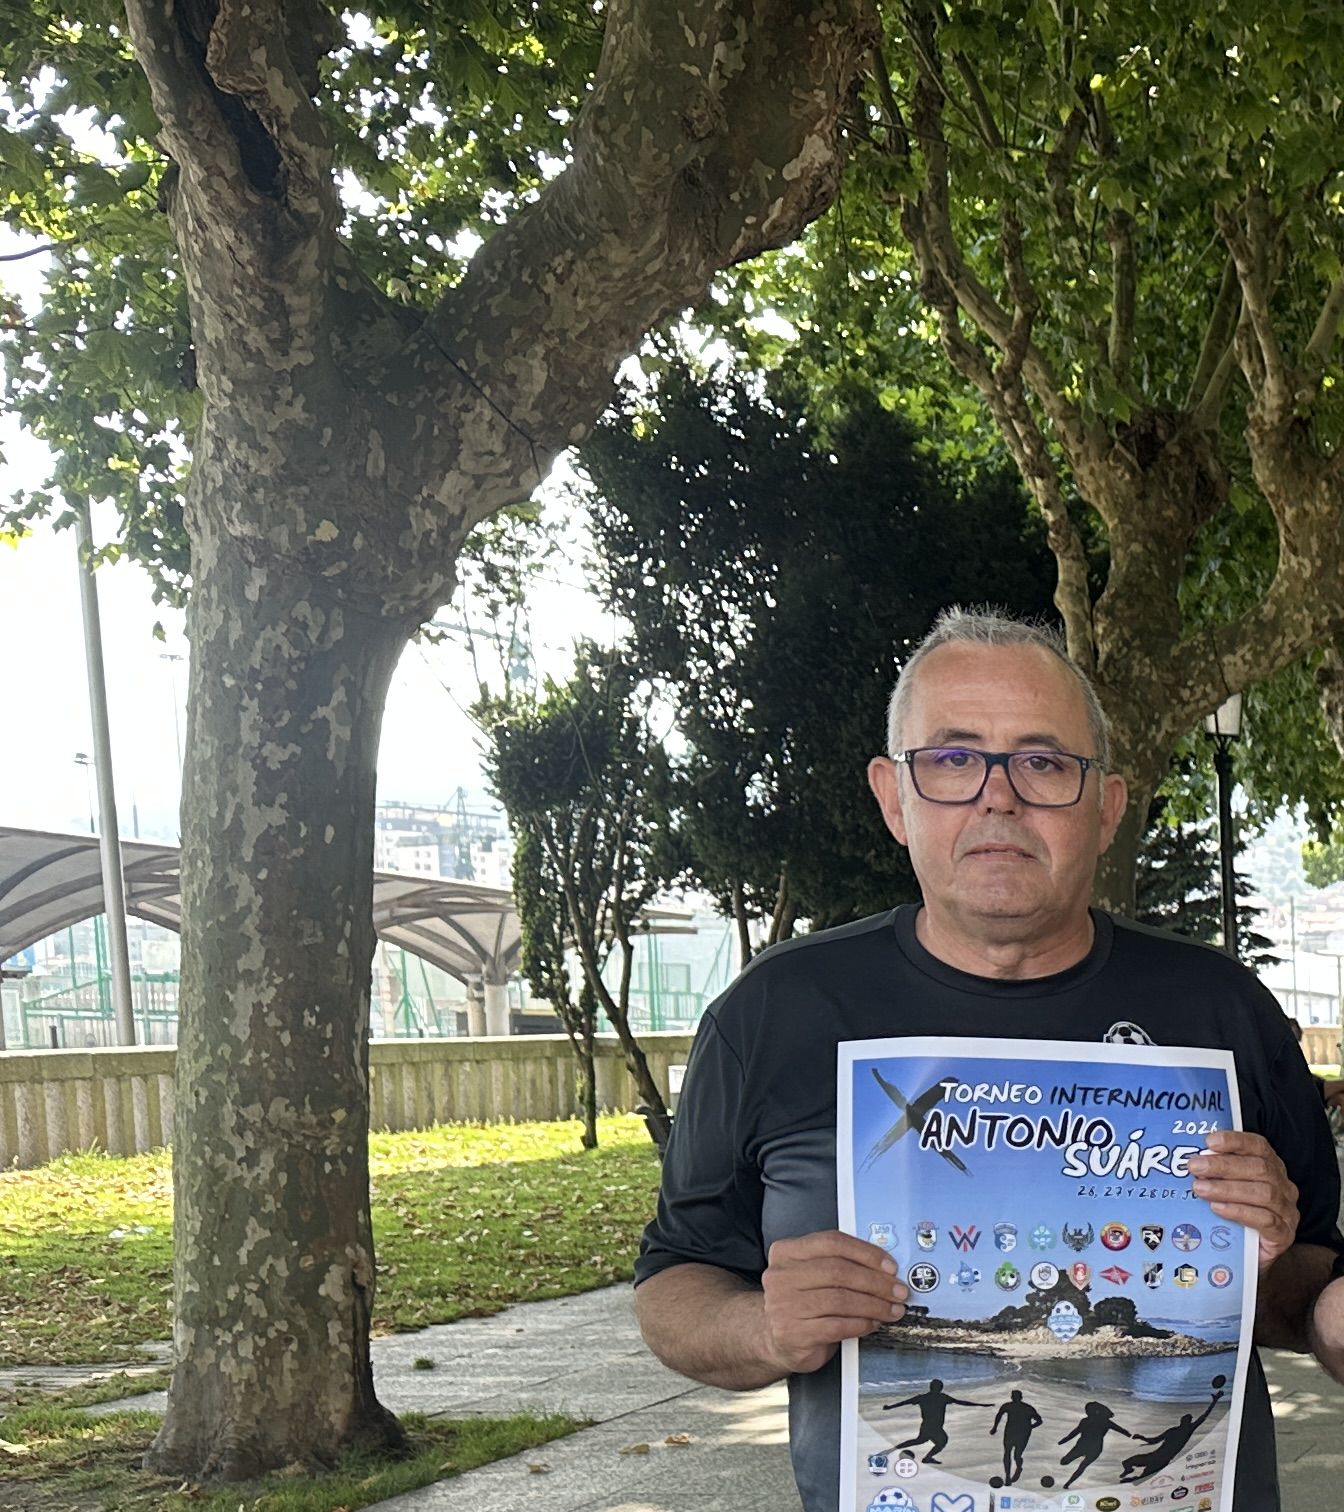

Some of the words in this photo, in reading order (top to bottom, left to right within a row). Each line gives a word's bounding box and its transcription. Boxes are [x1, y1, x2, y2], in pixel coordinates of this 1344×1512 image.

[939, 1080, 1042, 1104] TORNEO
[1050, 1083, 1225, 1112] INTERNACIONAL
[919, 1106, 1116, 1152] ANTONIO
[1062, 1127, 1220, 1181] SUÁRE
[1077, 1185, 1098, 1199] 26,
[1104, 1186, 1122, 1198] 27
[1139, 1186, 1157, 1199] 28
[1161, 1188, 1176, 1199] DE
